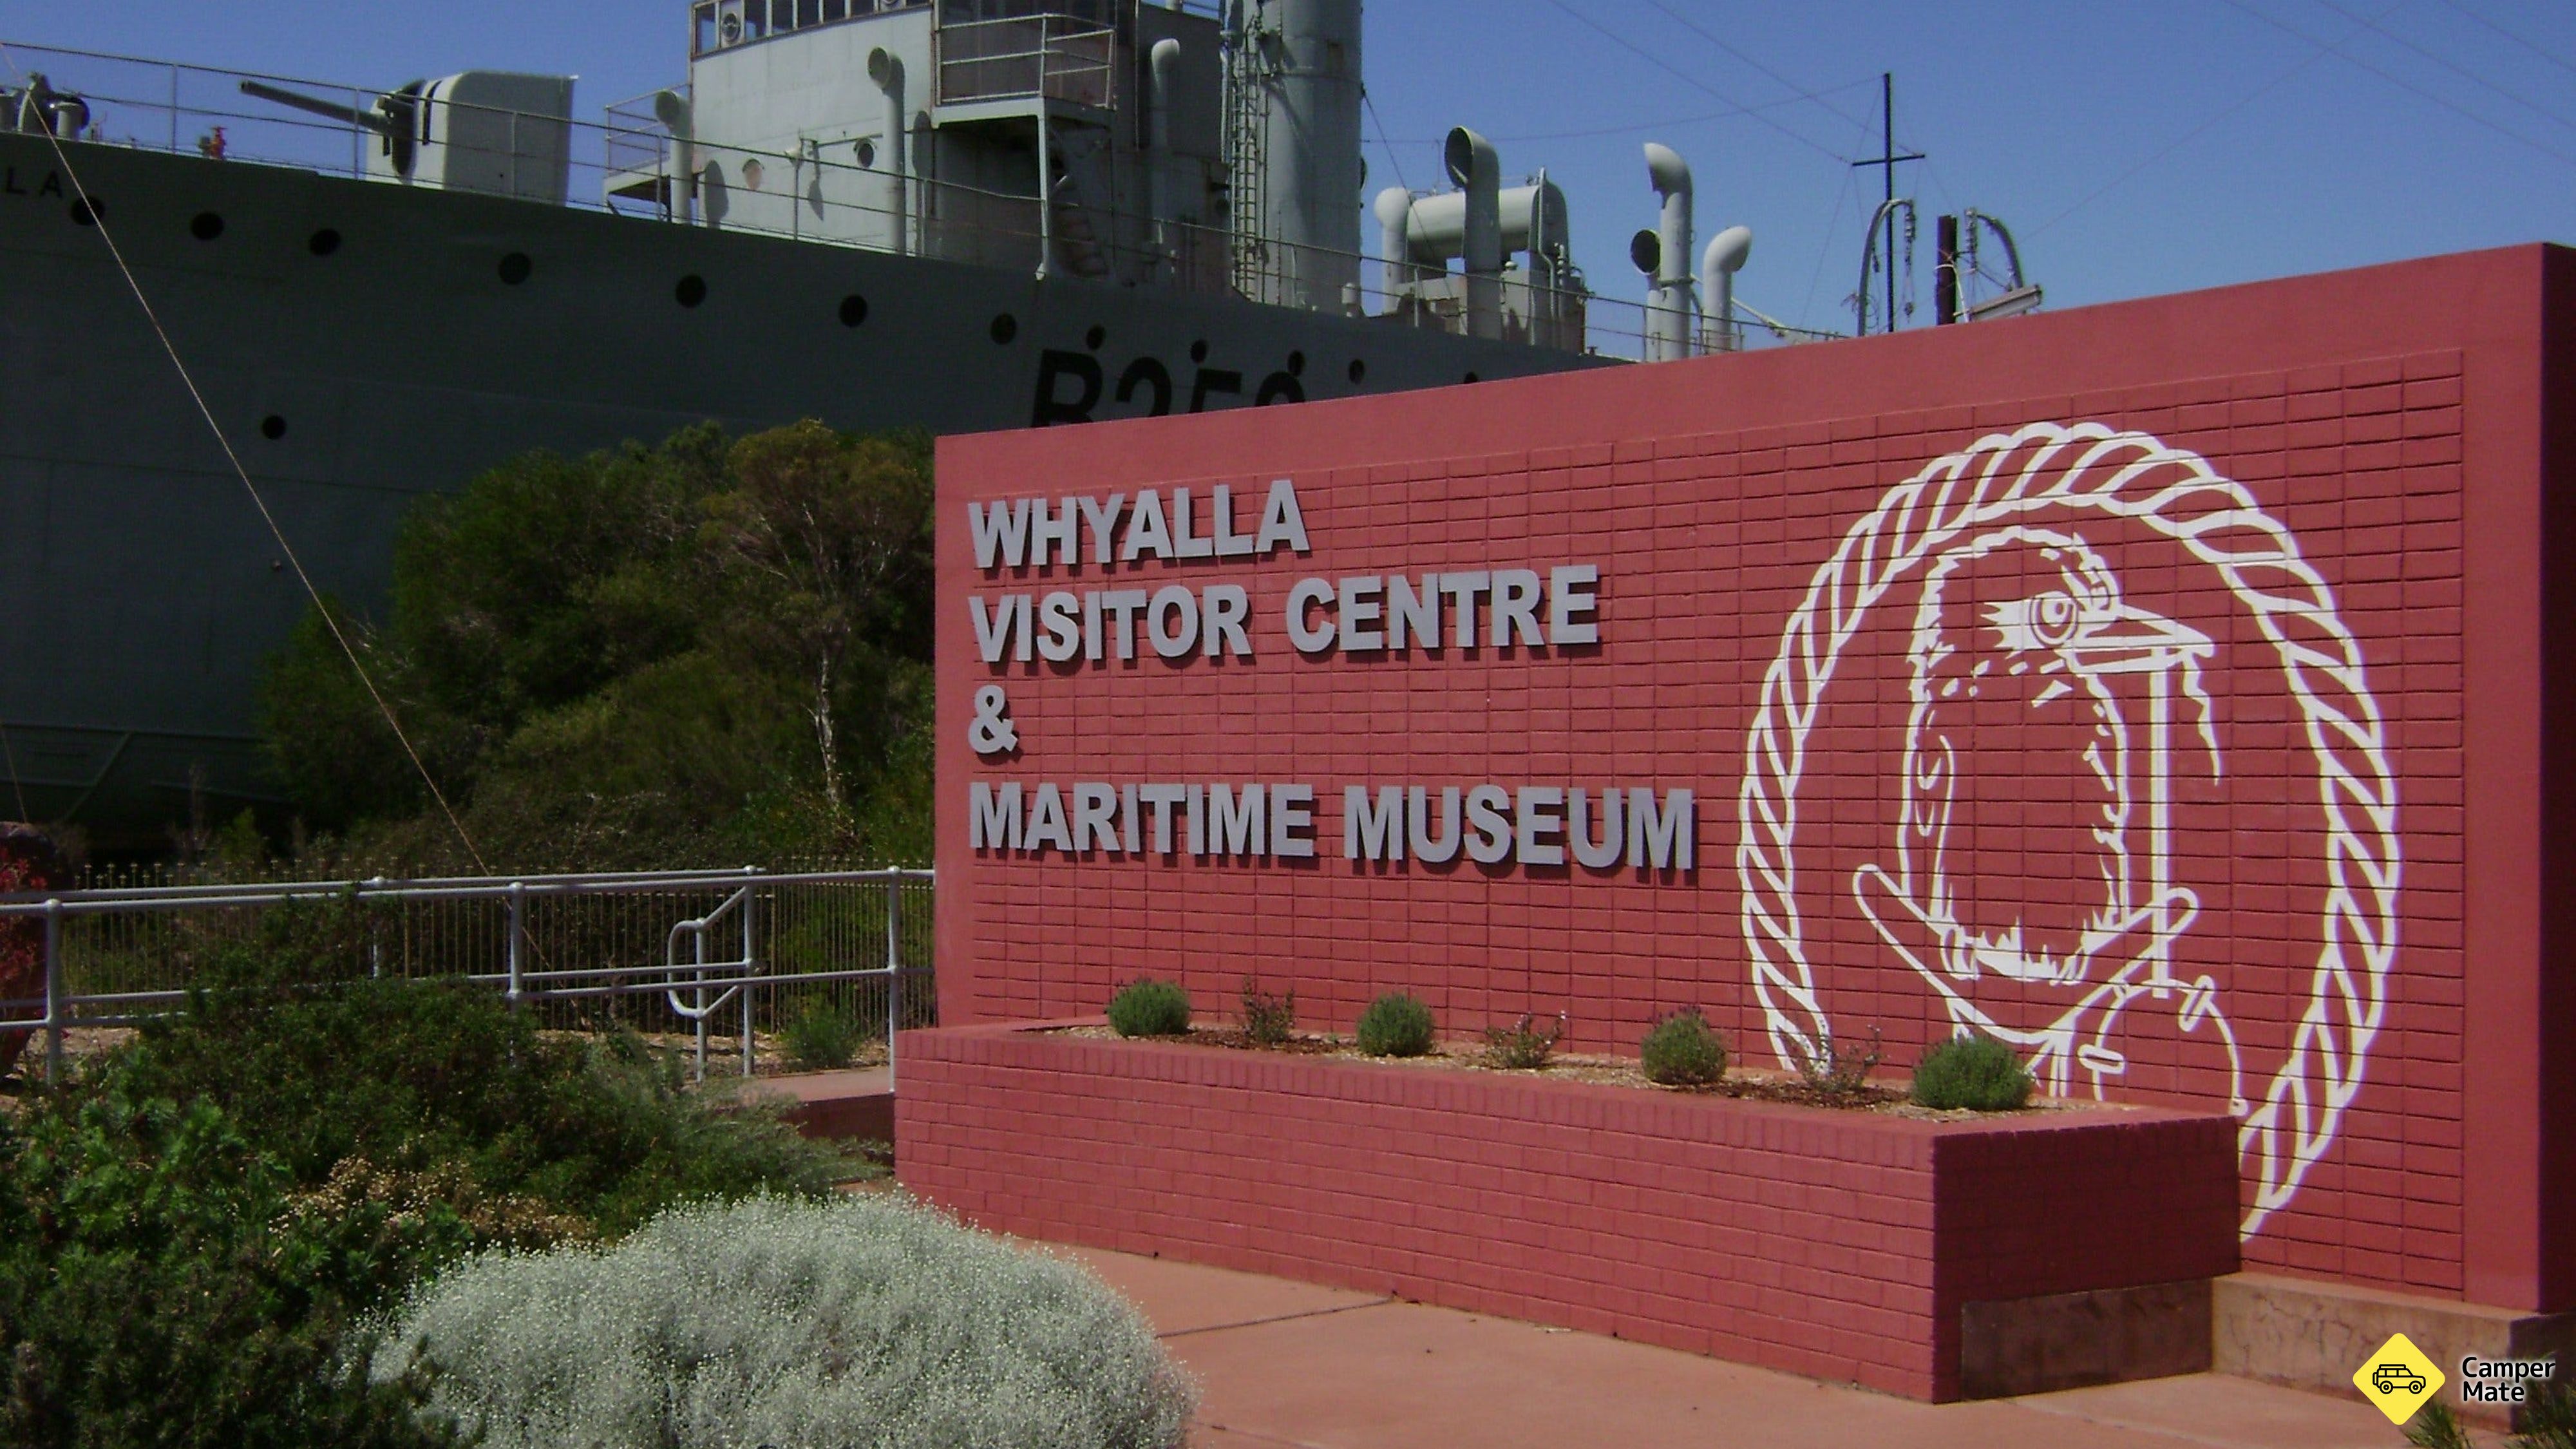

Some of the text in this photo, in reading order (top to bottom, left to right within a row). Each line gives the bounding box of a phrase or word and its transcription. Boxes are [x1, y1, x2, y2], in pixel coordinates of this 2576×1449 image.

[968, 479, 1310, 568] WHYALLA
[969, 564, 1598, 662] VISITOR CENTRE
[968, 685, 1018, 753] &
[969, 782, 1692, 869] MARITIME MUSEUM
